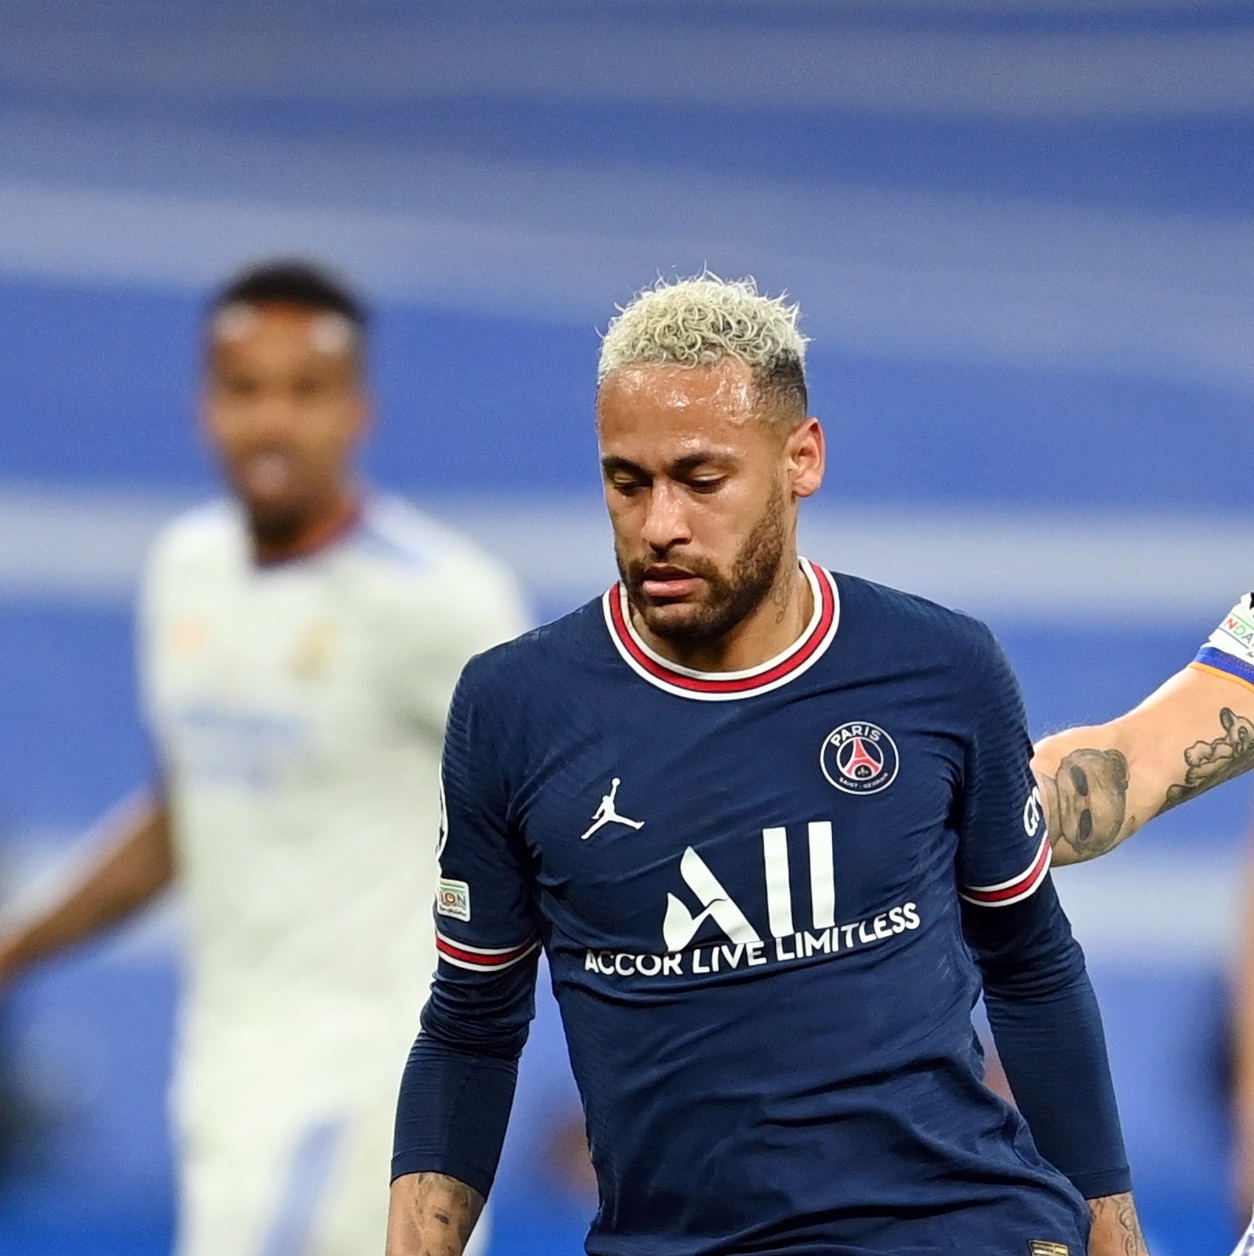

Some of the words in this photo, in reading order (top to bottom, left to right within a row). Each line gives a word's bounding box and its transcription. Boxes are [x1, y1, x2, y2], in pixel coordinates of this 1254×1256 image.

[831, 725, 881, 747] PARIS
[584, 949, 684, 976] ACCOR
[692, 941, 767, 973] LIVE
[776, 902, 921, 961] LIMITLESS
